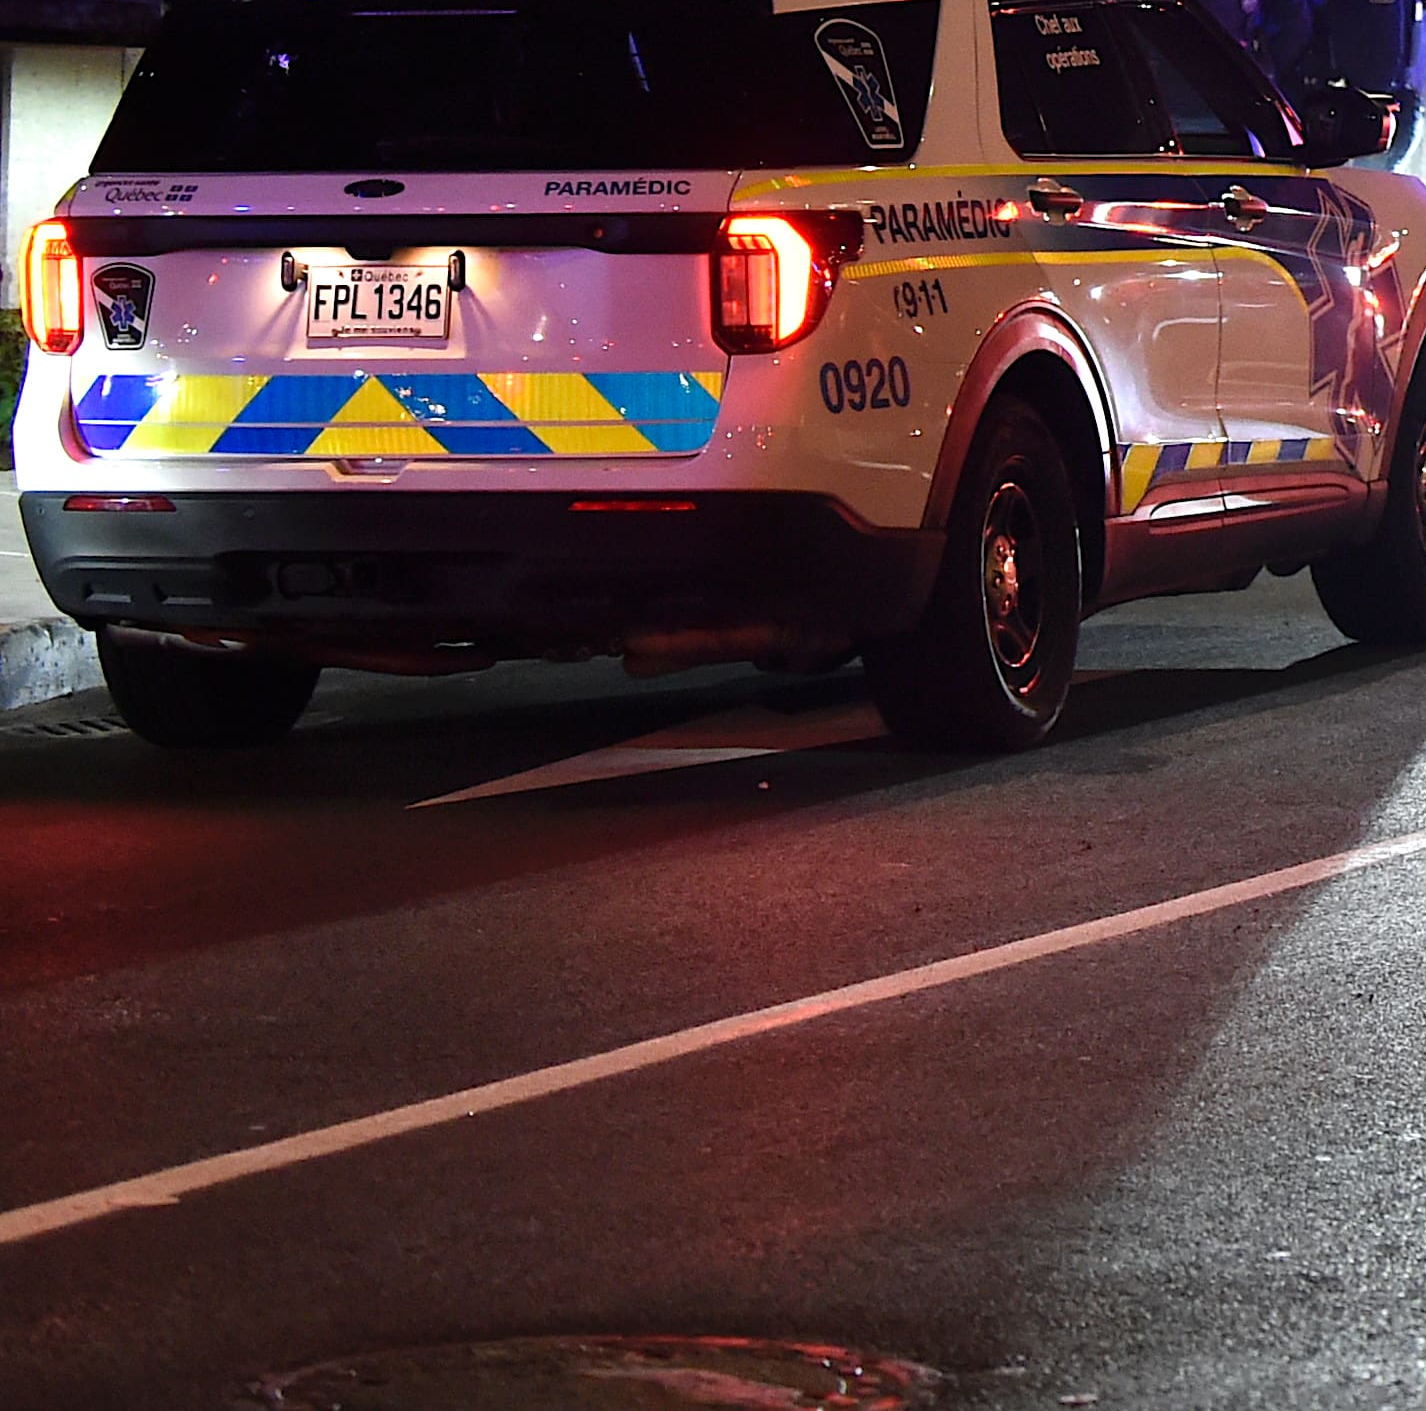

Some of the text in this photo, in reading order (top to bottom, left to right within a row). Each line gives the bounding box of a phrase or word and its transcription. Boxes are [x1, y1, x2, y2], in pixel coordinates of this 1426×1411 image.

[105, 188, 164, 203] Québec
[544, 177, 692, 196] PARAMÉDIC
[870, 190, 1010, 244] PARAMÉDIC
[364, 271, 409, 282] Québec
[819, 356, 911, 414] 0920
